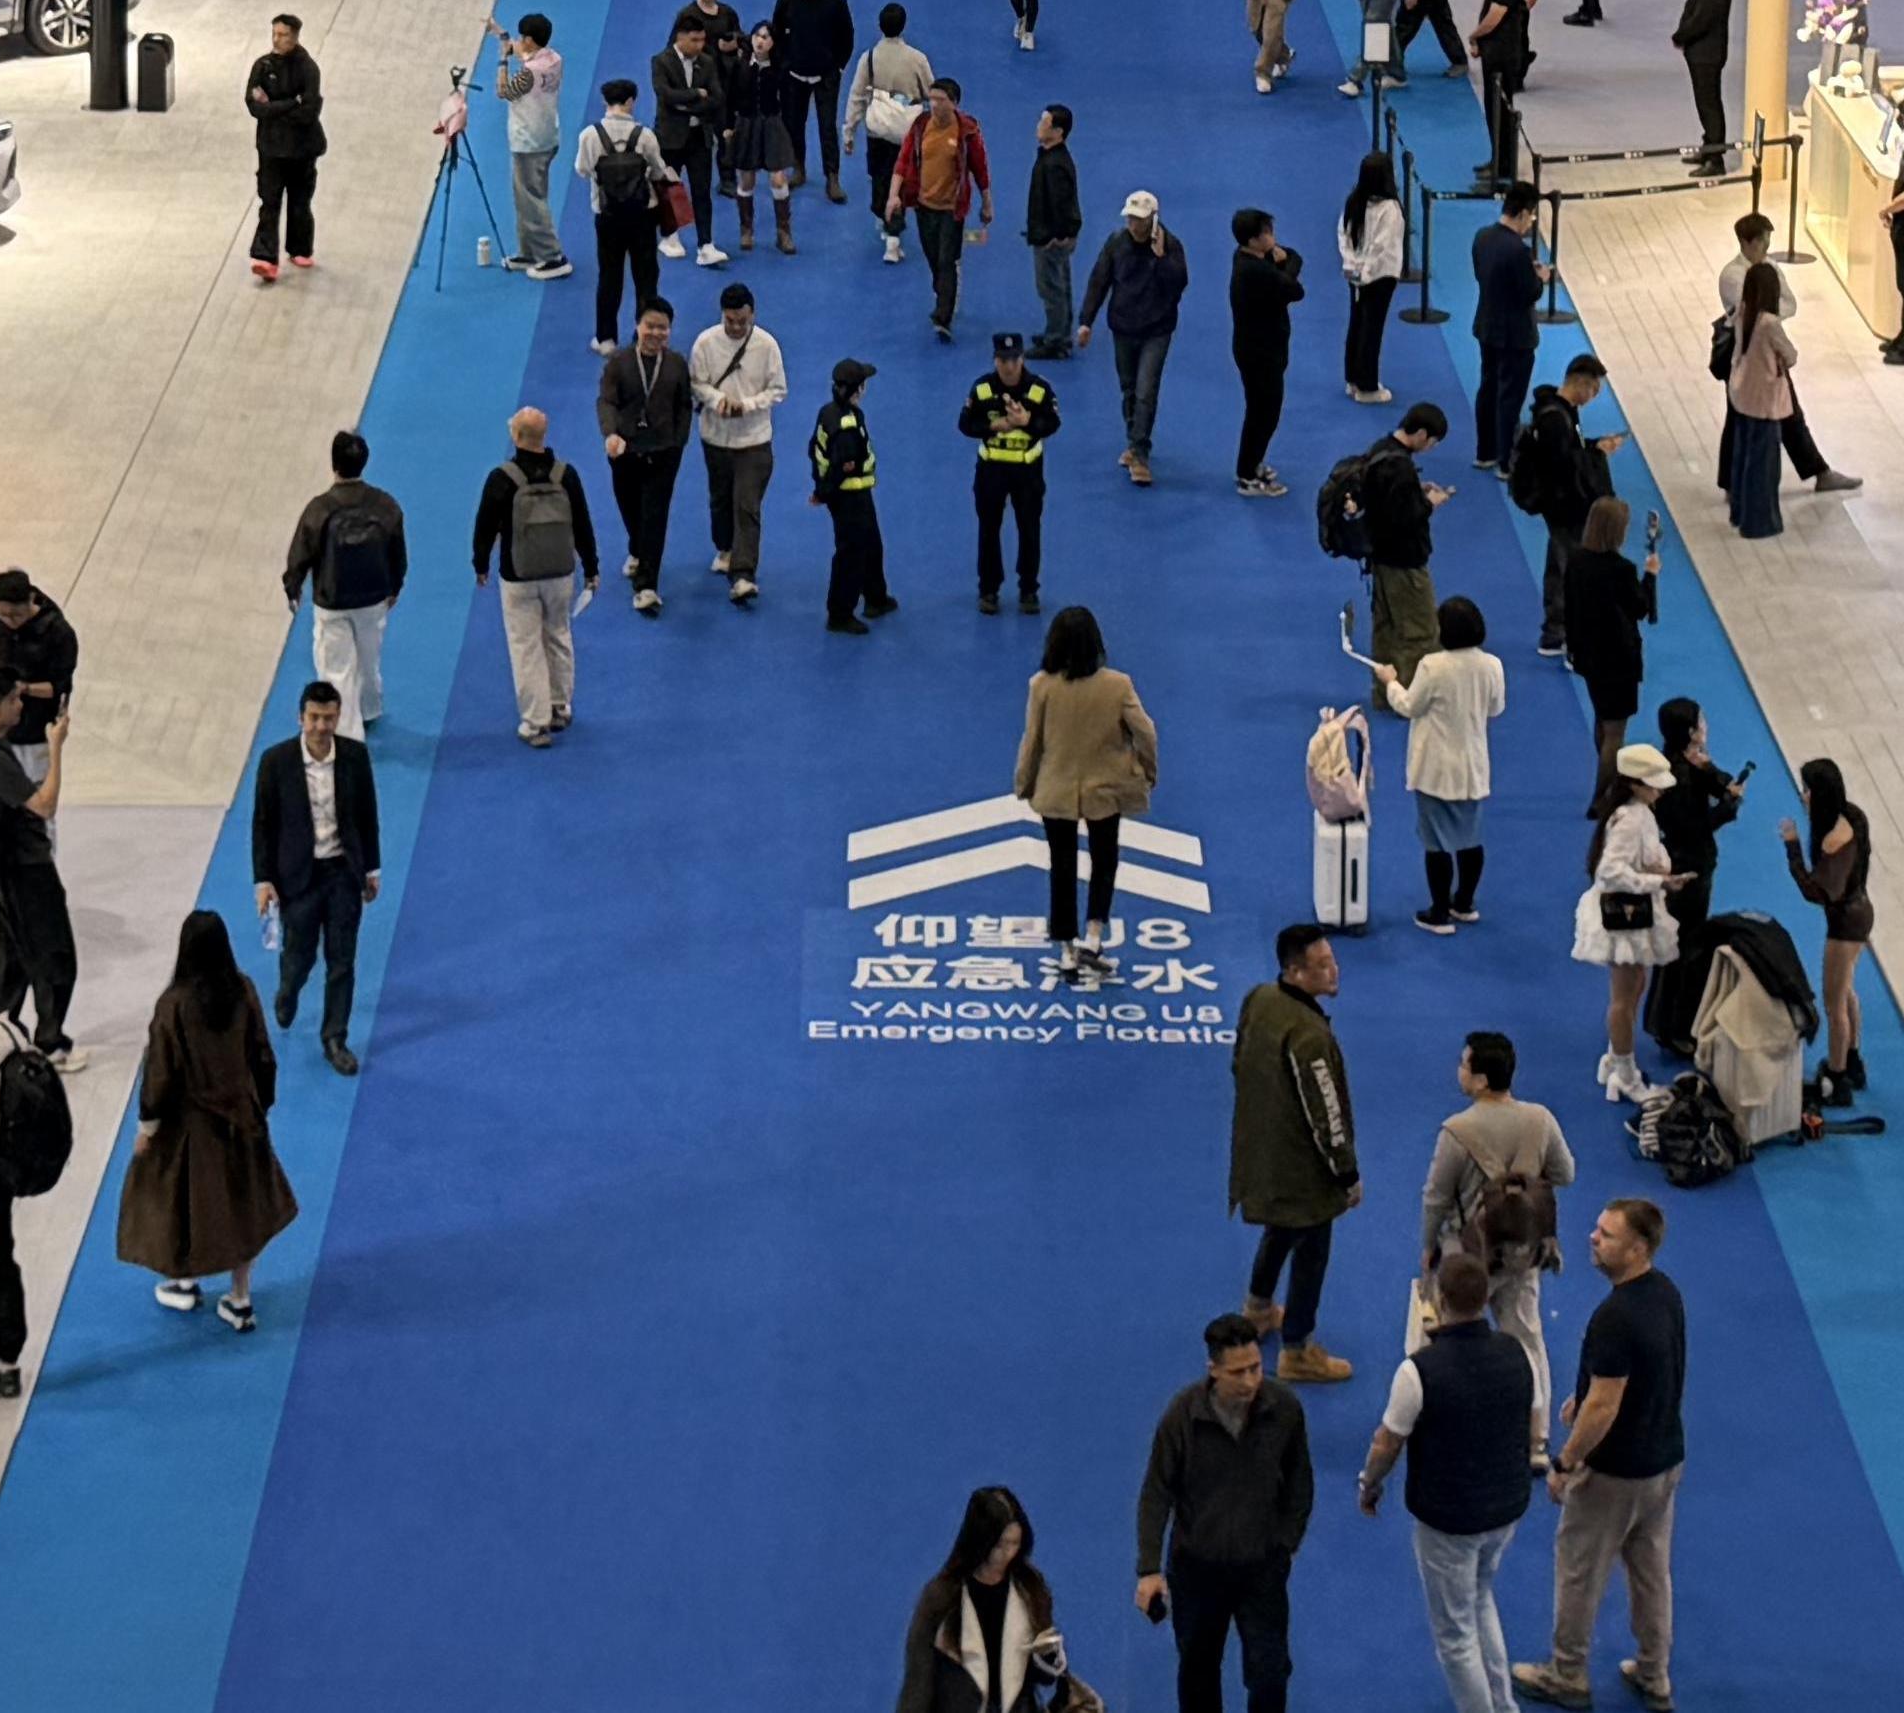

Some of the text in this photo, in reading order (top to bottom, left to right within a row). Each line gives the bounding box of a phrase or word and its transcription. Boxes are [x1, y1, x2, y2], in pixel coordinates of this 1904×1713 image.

[850, 1000, 1223, 1024] YANGWANG U8
[808, 1021, 1237, 1045] Emergency Flotatio
